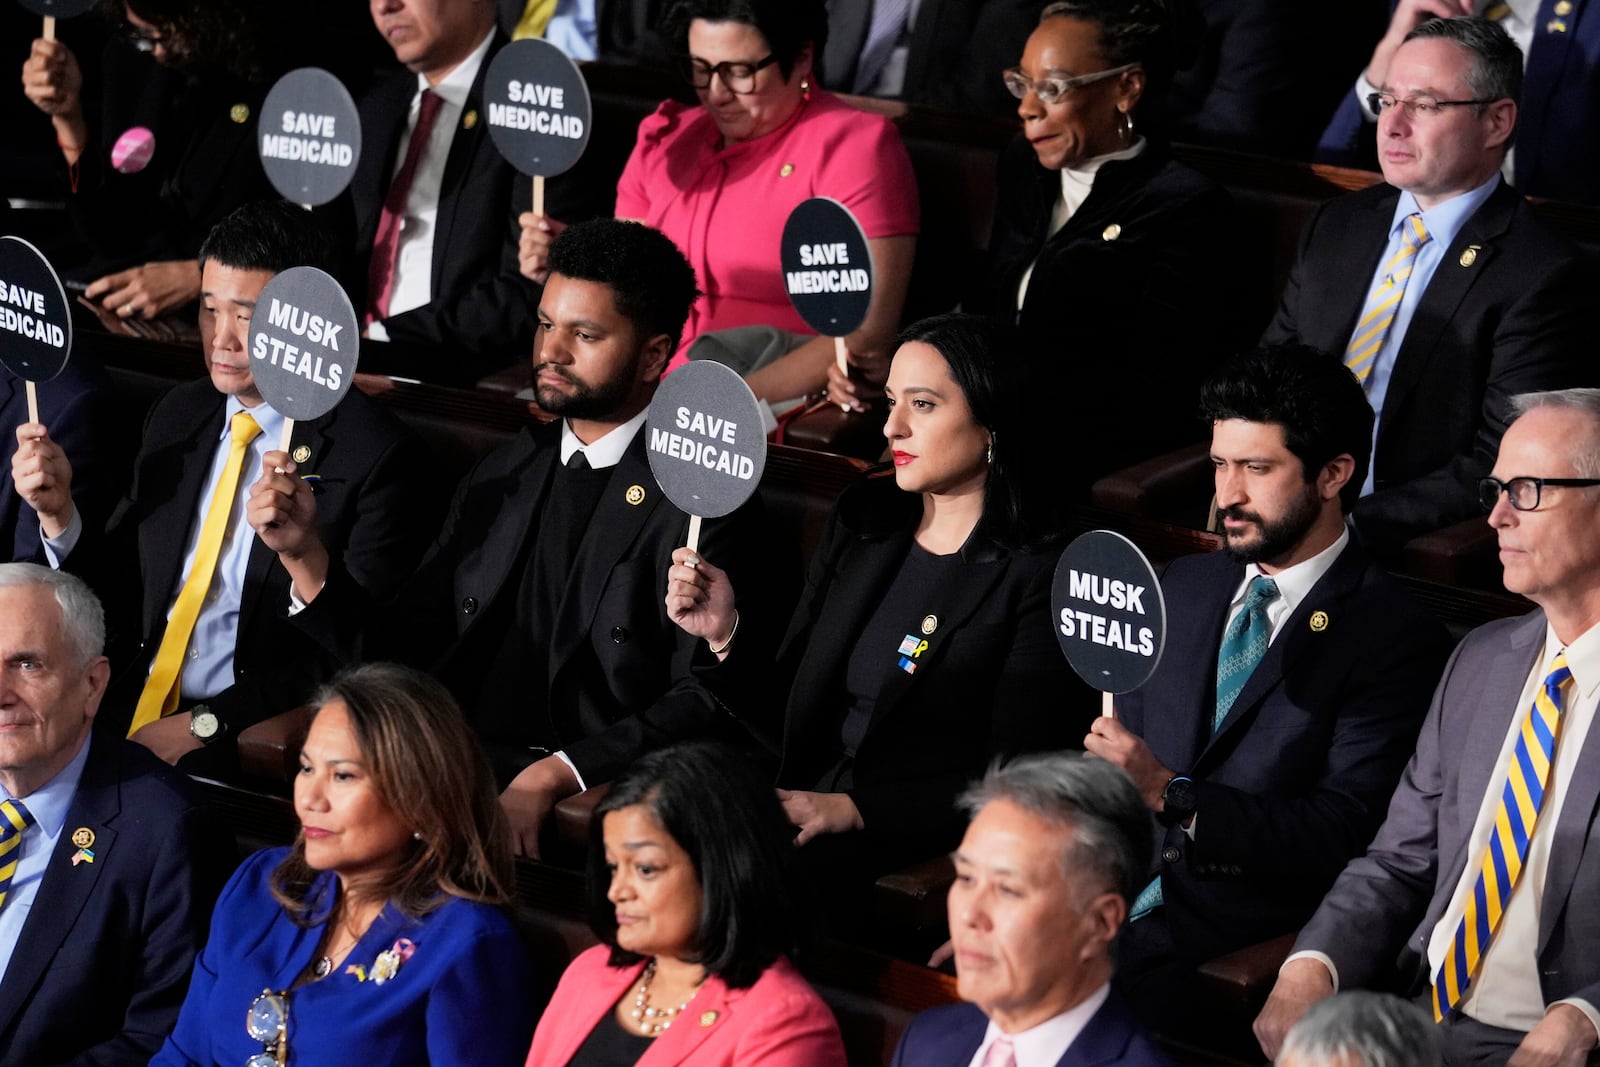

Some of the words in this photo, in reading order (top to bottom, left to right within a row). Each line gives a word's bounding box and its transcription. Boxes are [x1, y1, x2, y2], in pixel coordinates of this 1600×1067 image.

[508, 80, 564, 110] SAVE
[281, 110, 336, 138] SAVE
[489, 103, 584, 140] MEDICAID
[262, 133, 353, 169] MEDICAID
[799, 242, 850, 268] SAVE
[786, 269, 869, 295] MEDICAID
[267, 297, 344, 352] MUSK
[252, 331, 343, 391] STEALS
[675, 406, 738, 445] SAVE
[650, 427, 755, 481] MEDICAID
[1069, 569, 1146, 615] MUSK
[1060, 607, 1154, 657] STEALS
